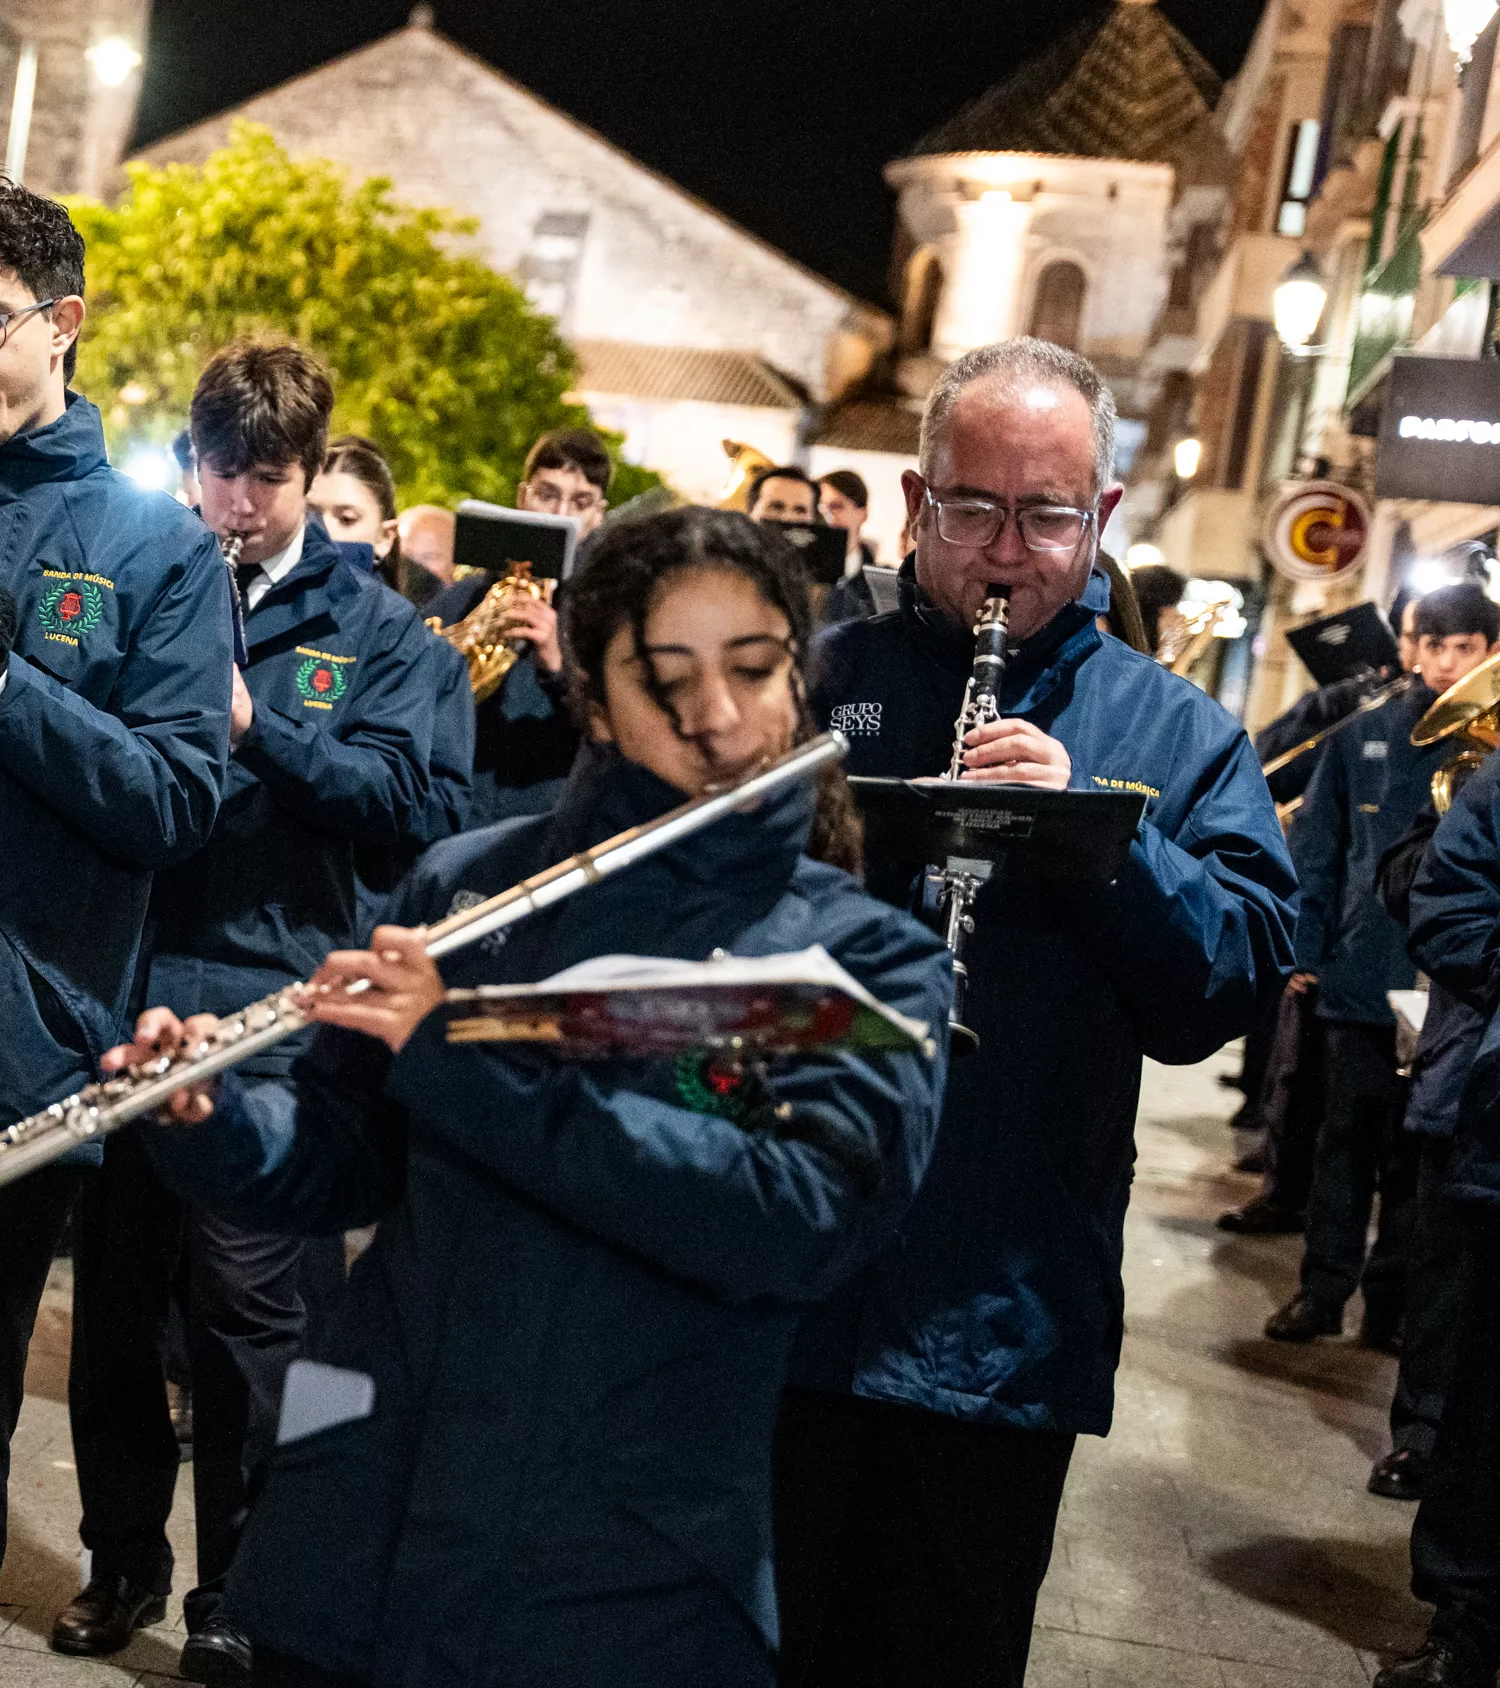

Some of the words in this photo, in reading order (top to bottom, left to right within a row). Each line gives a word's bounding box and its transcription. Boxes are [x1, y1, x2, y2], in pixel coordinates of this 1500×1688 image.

[43, 569, 71, 579] BANDA
[73, 572, 83, 580] DE
[84, 573, 114, 590] MÚSICA
[44, 632, 79, 646] LUCENA
[831, 702, 883, 718] GRUPO
[830, 714, 881, 731] SEYS
[1110, 779, 1124, 789] DE
[1126, 780, 1160, 798] MÚSICA
